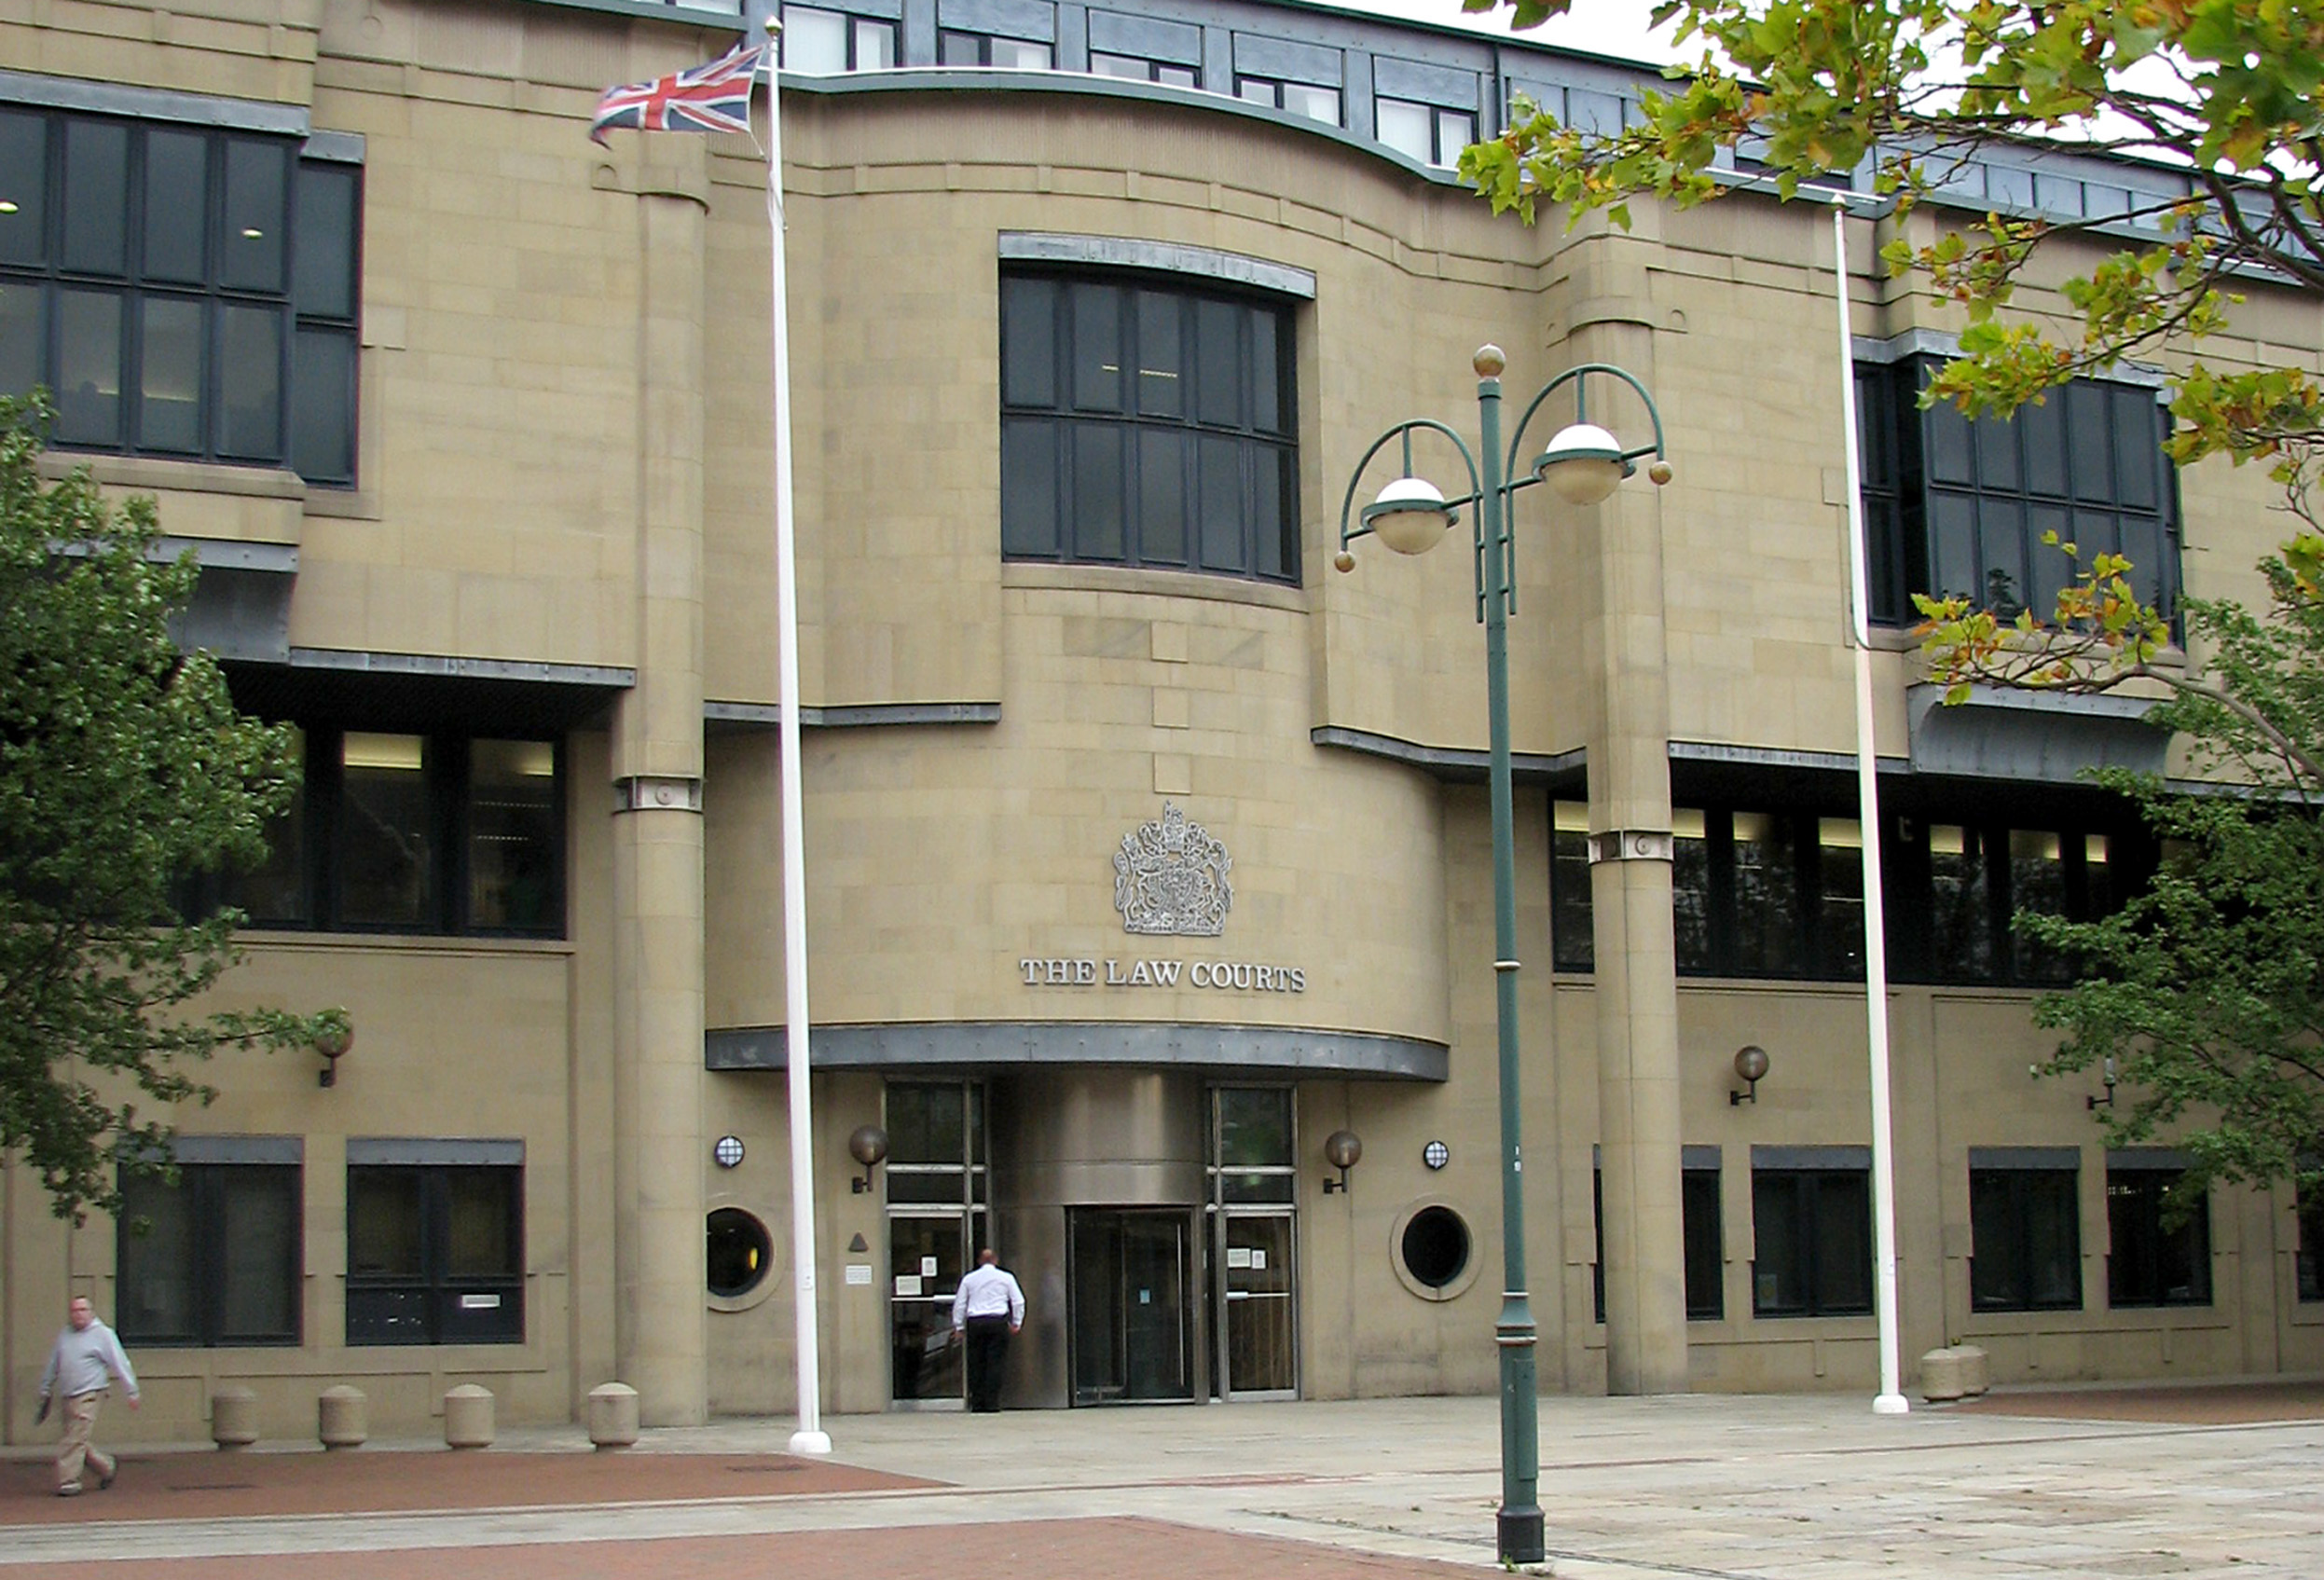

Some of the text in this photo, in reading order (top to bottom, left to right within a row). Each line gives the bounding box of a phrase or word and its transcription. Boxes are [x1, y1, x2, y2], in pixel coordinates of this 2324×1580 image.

[1020, 959, 1305, 993] THE LAW COURTS
